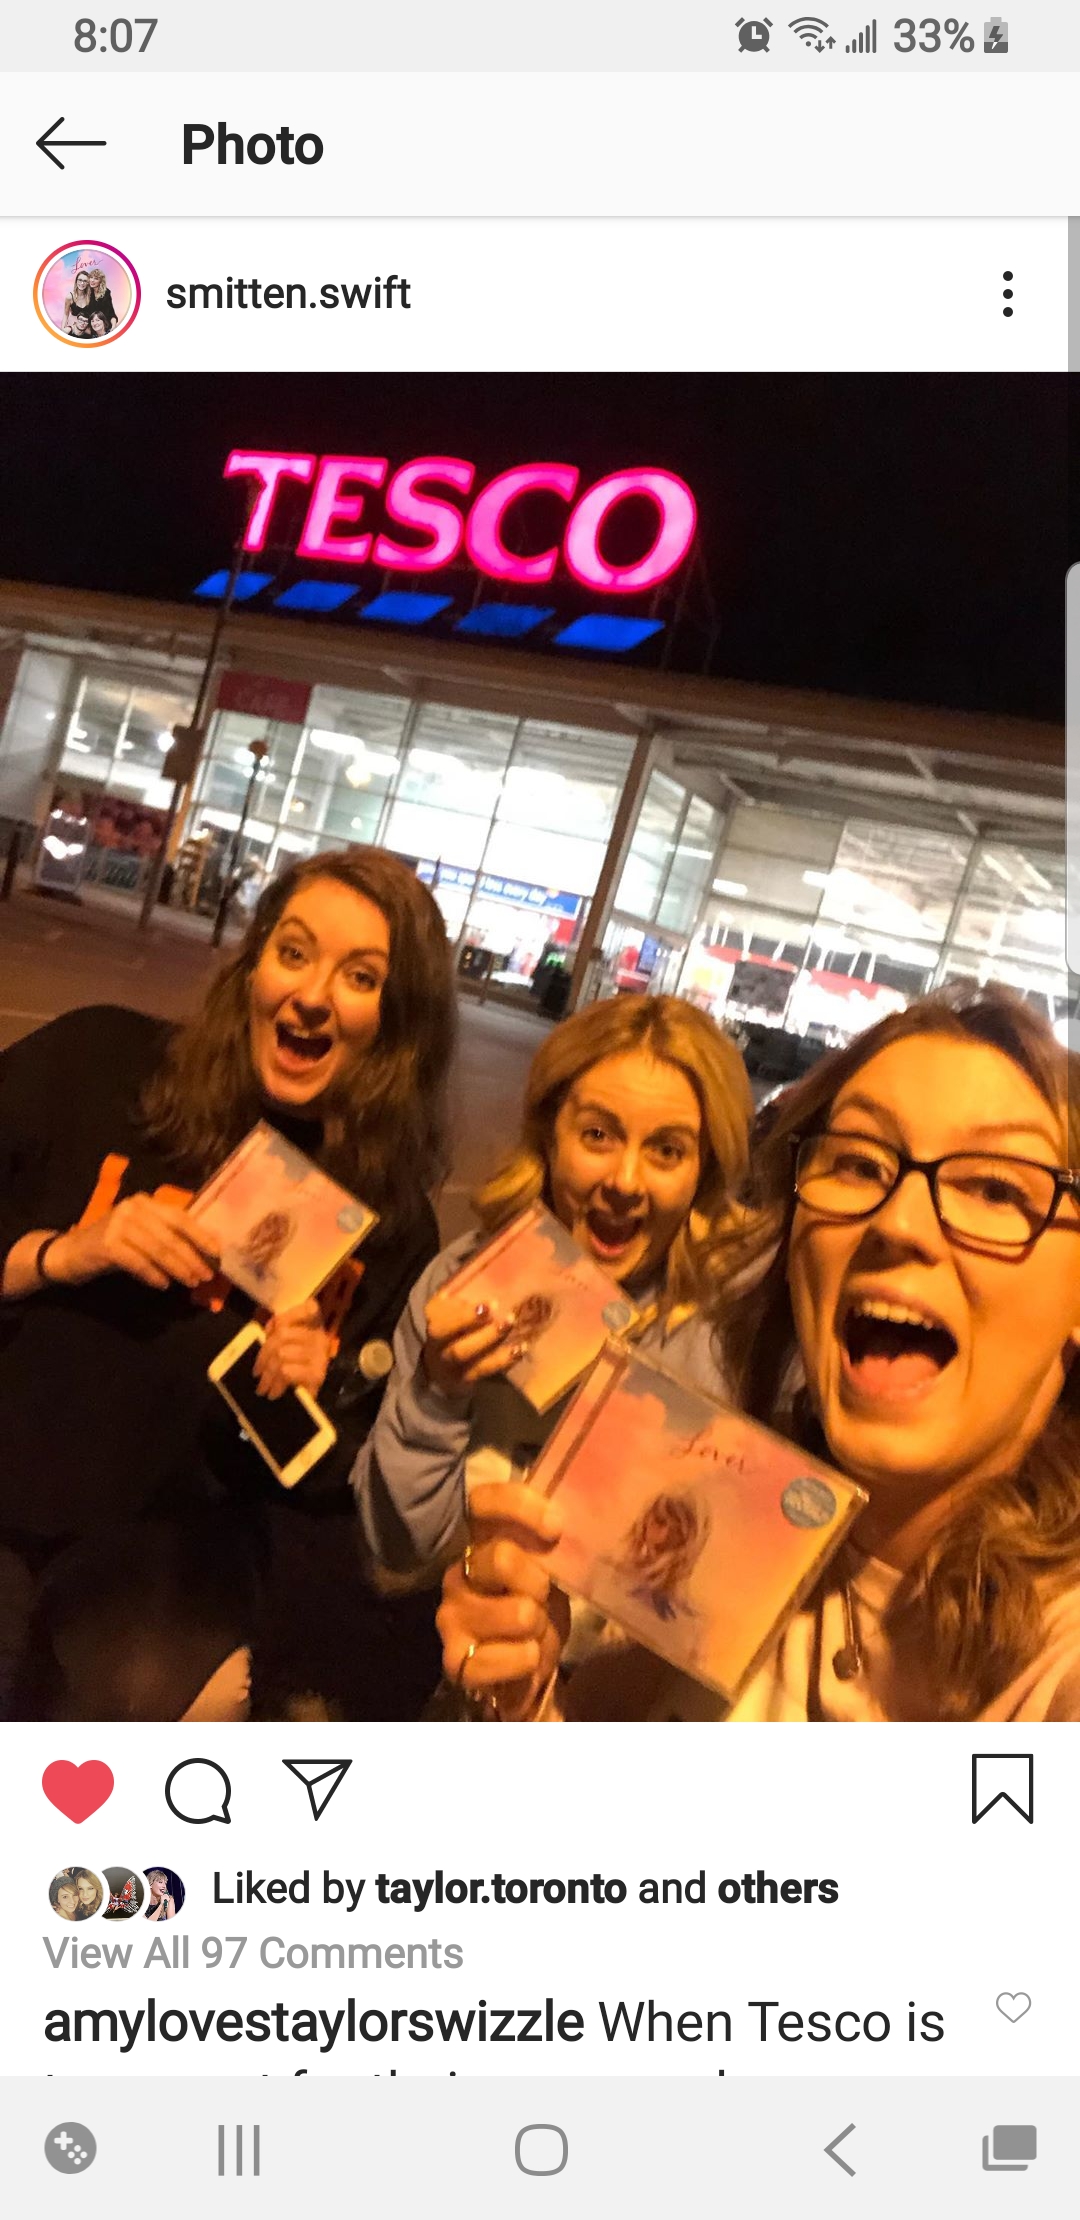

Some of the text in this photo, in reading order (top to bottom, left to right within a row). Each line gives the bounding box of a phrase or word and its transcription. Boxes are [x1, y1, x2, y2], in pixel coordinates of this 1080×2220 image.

[73, 17, 159, 54] 8:07
[893, 17, 975, 54] 33%
[183, 121, 324, 166] Photo
[166, 274, 412, 310] smitten.swift
[223, 449, 697, 593] TESCO
[213, 1869, 839, 1913] Liked by taylor.toronto and others
[42, 1934, 464, 1970] View All 97 Comments
[44, 1997, 945, 2054] amylovestaylorswizzle When Tesco is
